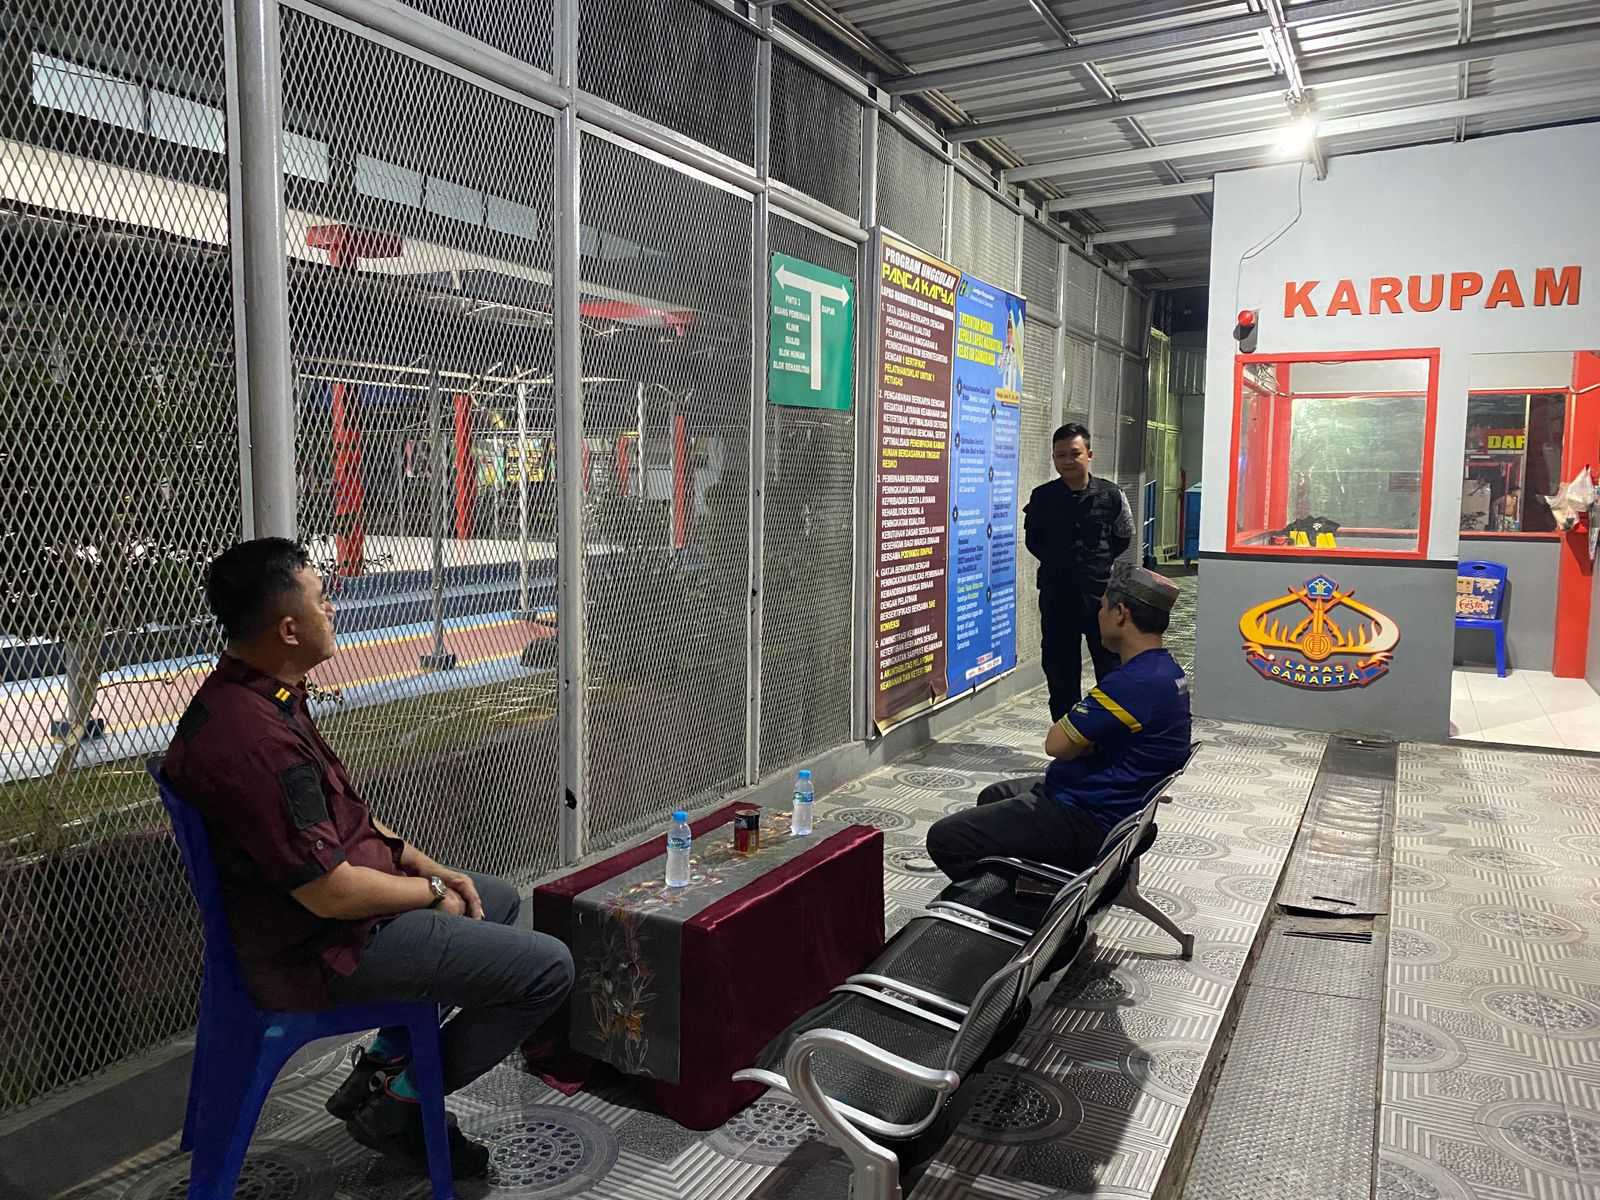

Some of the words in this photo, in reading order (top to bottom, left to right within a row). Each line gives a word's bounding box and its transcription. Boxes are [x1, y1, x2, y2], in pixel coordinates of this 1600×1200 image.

[885, 247, 921, 275] PROGRAM
[921, 263, 956, 290] UNGGULAN
[882, 262, 920, 292] PANCA
[921, 279, 954, 306] KARYA
[1284, 265, 1582, 318] KARUPAM
[886, 316, 913, 331] PENINGKATAN
[885, 328, 914, 343] PELAKSANAAN
[885, 340, 913, 354] PENINGKATAN
[885, 352, 902, 363] DENGAN
[882, 486, 908, 494] PENINGKATAN
[909, 486, 926, 494] LAYANAN
[881, 508, 907, 517] REHABILITASI
[881, 519, 908, 528] PENINGKATAN
[880, 575, 907, 588] PENINGKATAN
[907, 572, 924, 582] KUALITAS
[880, 599, 897, 610] DENGAN
[897, 594, 917, 606] PELATIHAN
[880, 654, 907, 669] PENINGKATAN
[1285, 659, 1345, 673] LAPAS
[1271, 665, 1360, 685] SAMAPTA
